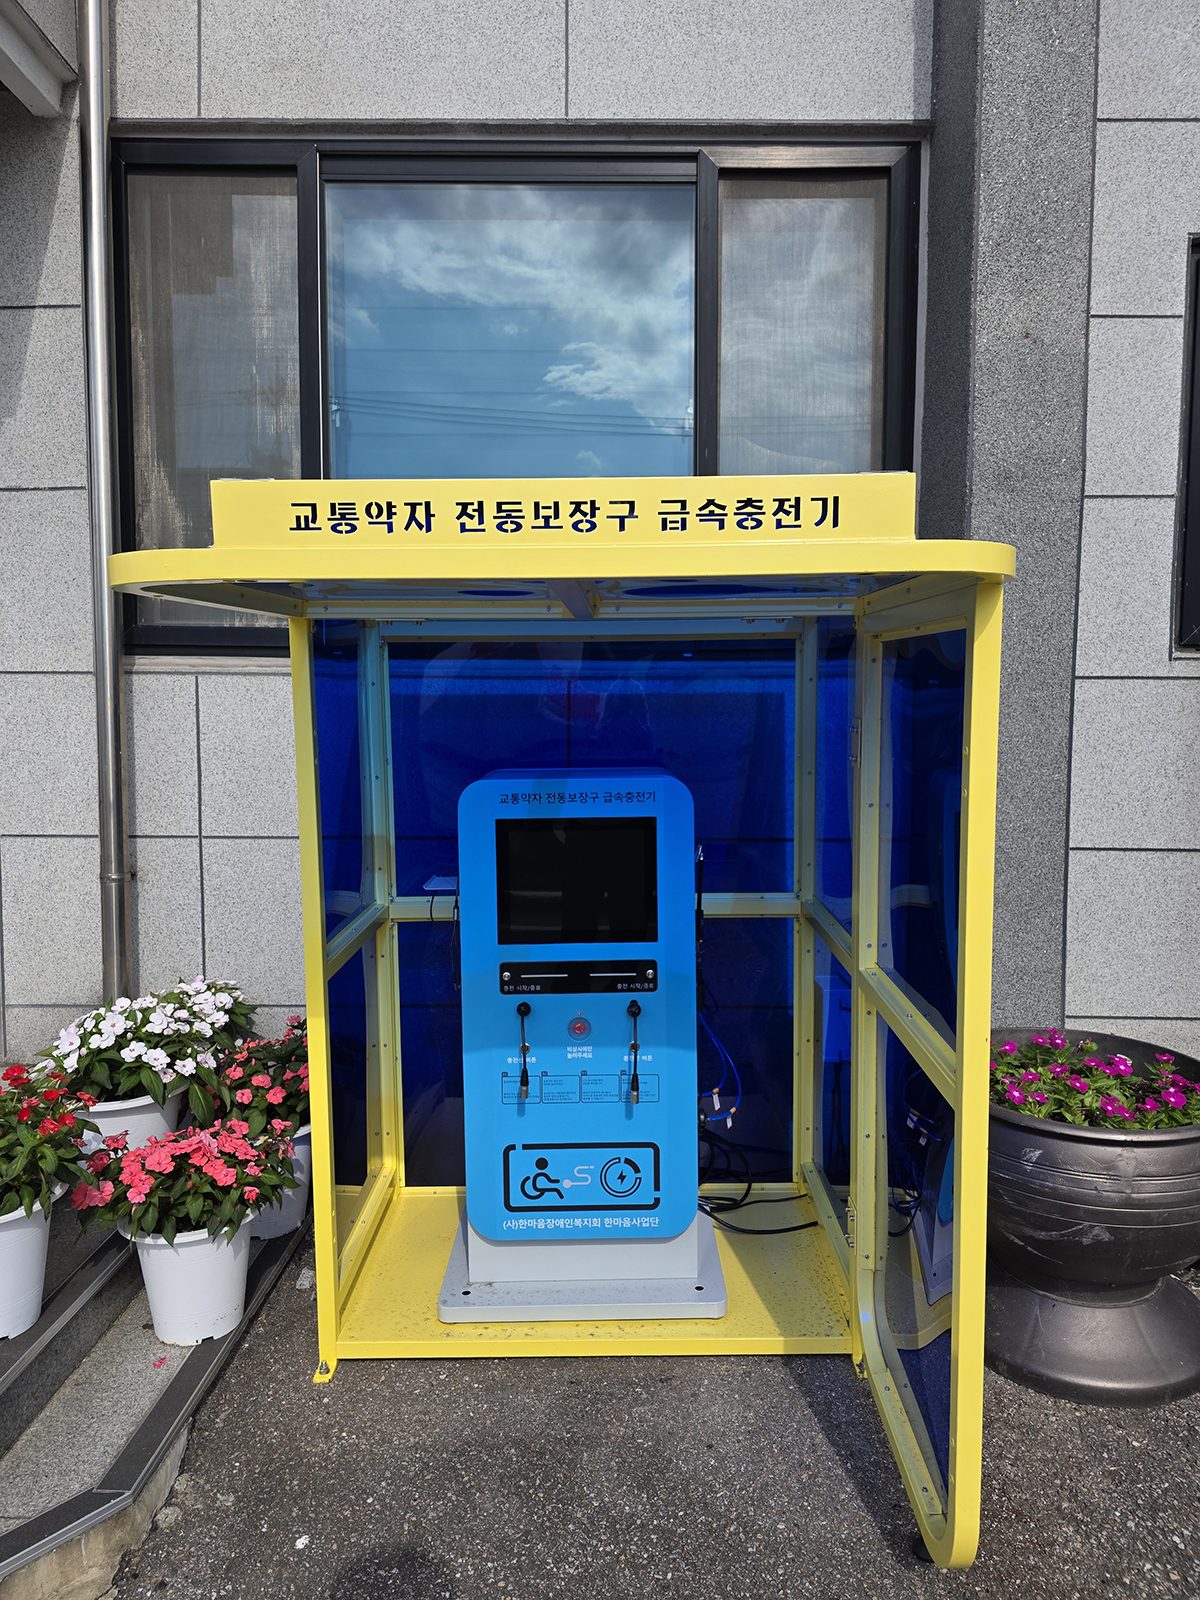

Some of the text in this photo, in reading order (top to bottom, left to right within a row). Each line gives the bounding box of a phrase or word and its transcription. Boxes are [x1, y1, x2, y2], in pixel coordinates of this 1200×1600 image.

[289, 496, 840, 534] 교통약자 전동보장구 급속충전기
[499, 790, 657, 805] 교통약자 전동보장구 급속충전기
[502, 1216, 660, 1231] (사)한마음장애인복지회 한마음사업단
